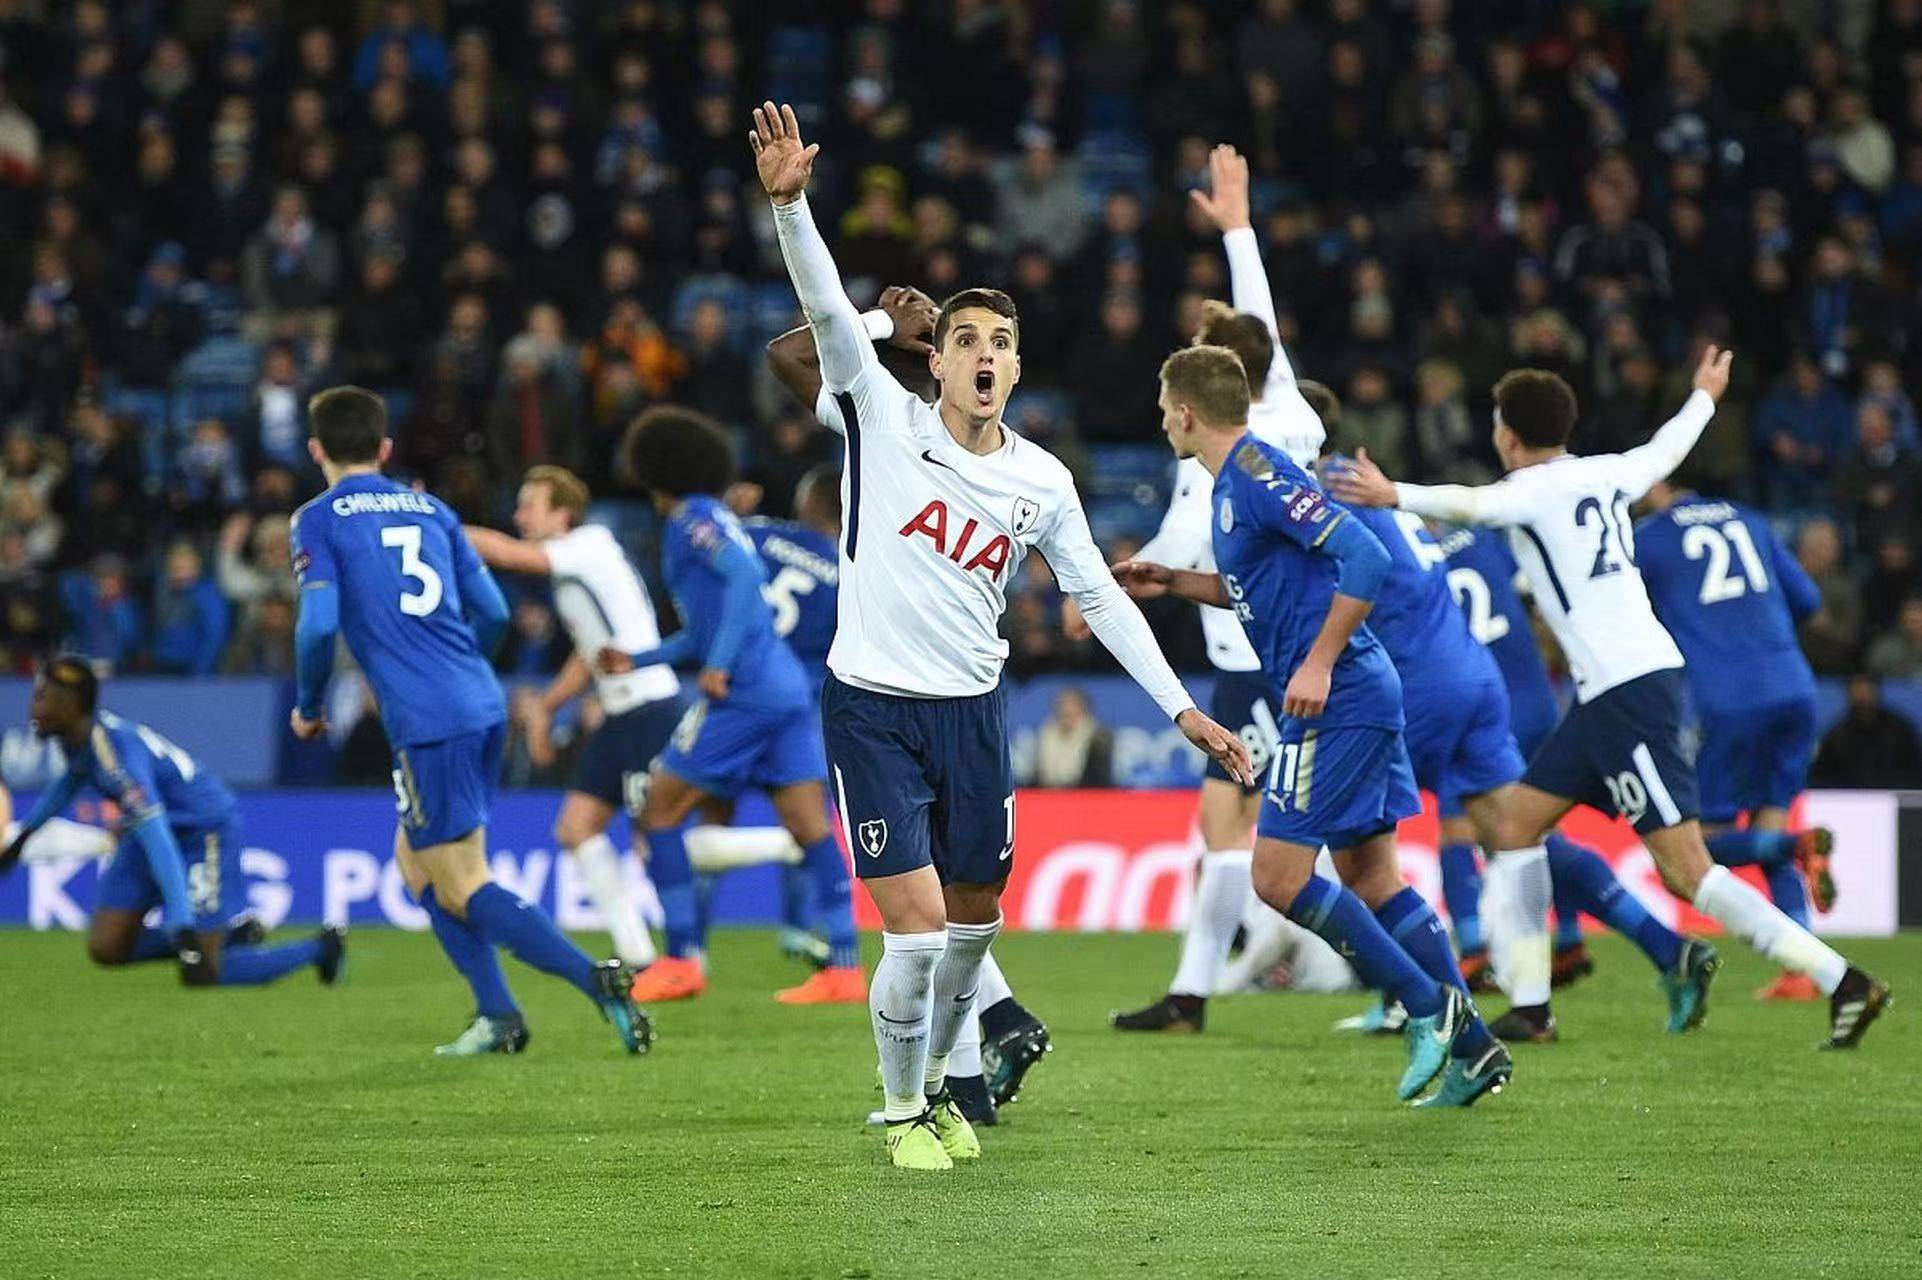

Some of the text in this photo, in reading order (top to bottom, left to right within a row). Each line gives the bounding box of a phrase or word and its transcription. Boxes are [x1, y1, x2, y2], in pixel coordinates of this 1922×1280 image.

[381, 525, 443, 617] 3
[898, 499, 1011, 583] AIA
[1682, 519, 1769, 605] 21
[1269, 743, 1299, 793] 11
